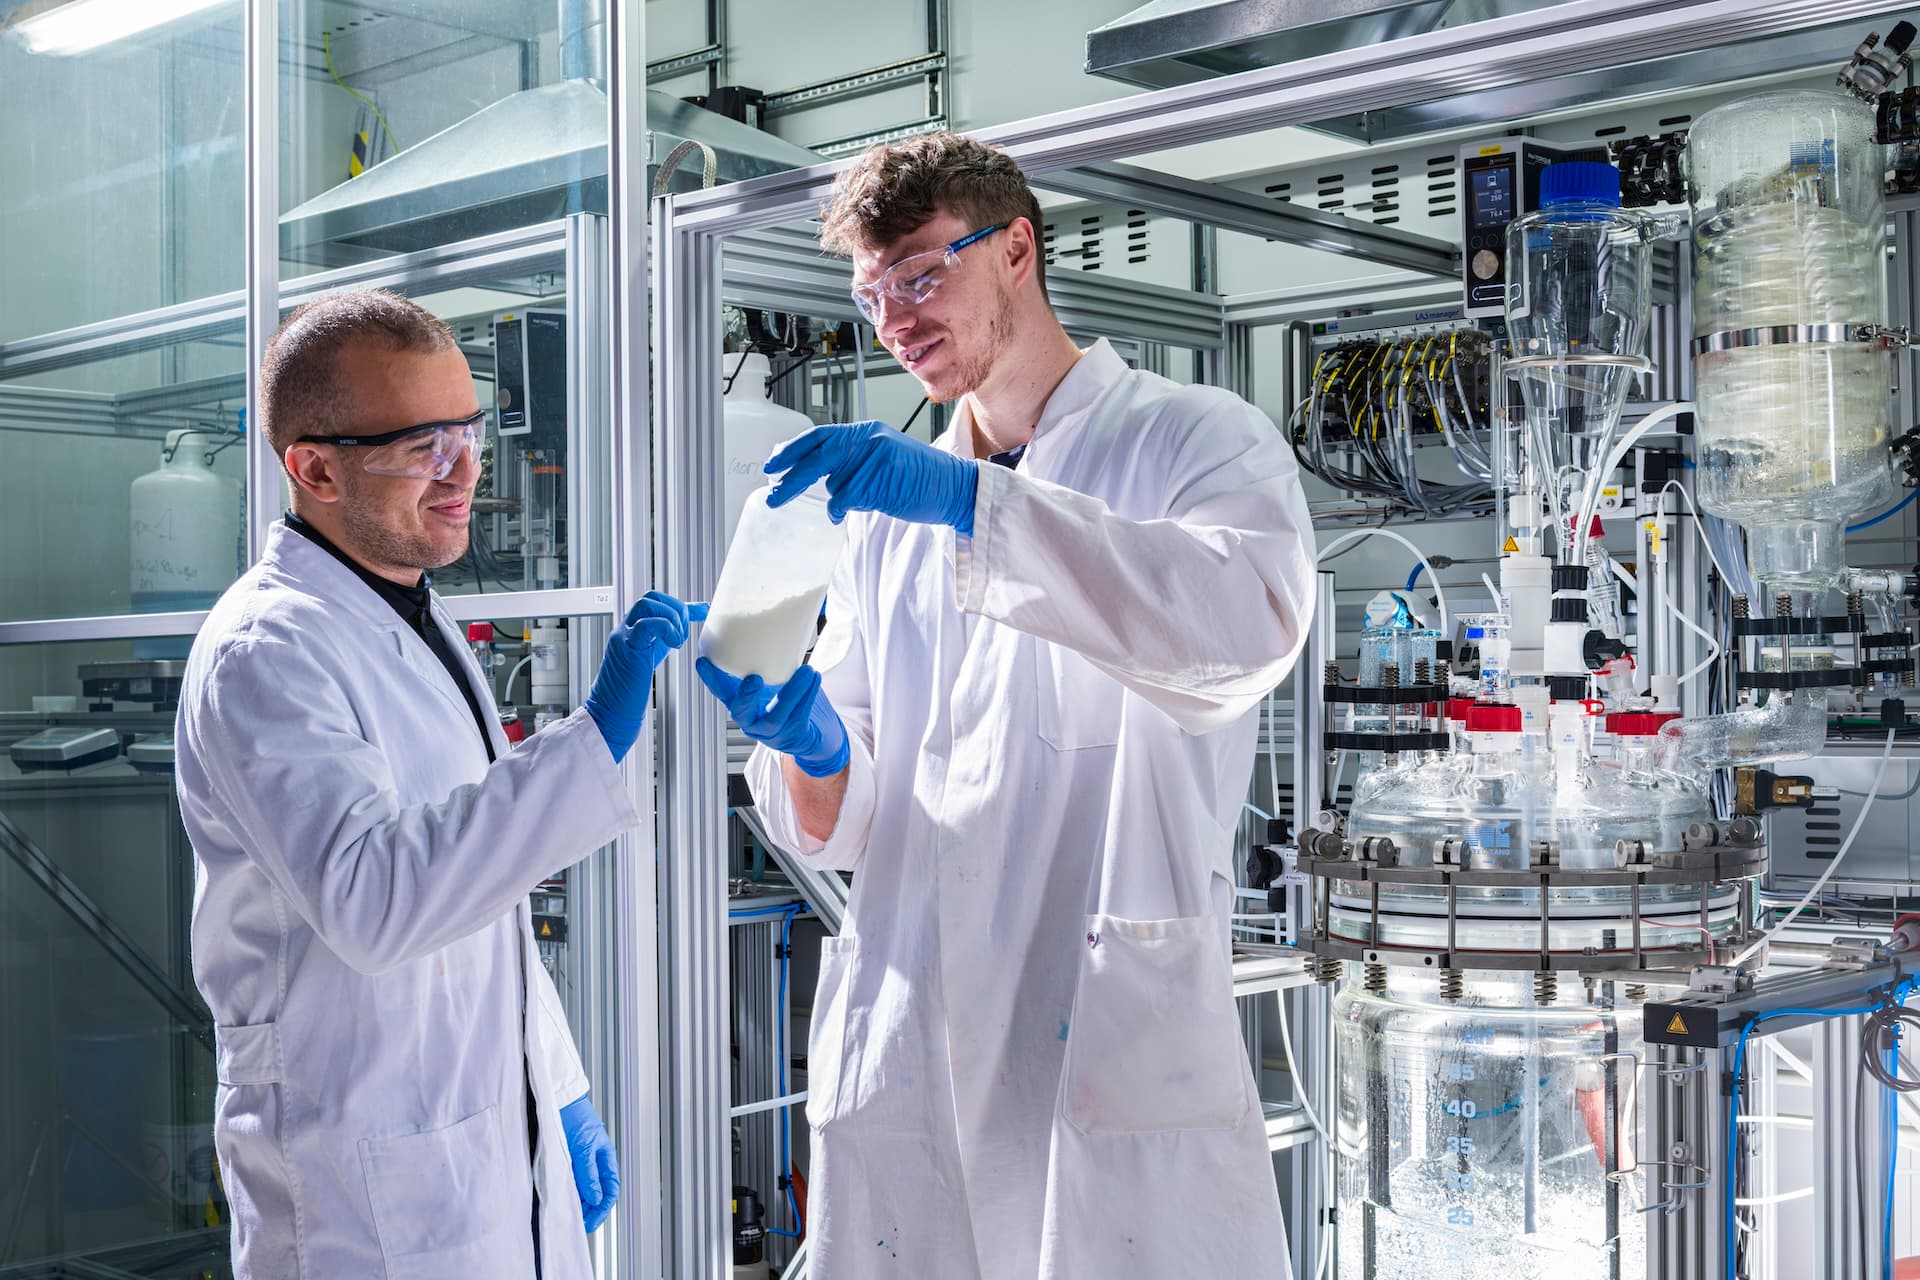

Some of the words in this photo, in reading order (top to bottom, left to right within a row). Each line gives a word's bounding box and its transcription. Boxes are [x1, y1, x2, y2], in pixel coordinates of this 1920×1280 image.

[1447, 1063, 1475, 1081] 45
[1446, 1100, 1477, 1118] 40
[1446, 1136, 1474, 1157] 35
[1447, 1207, 1474, 1226] 25
